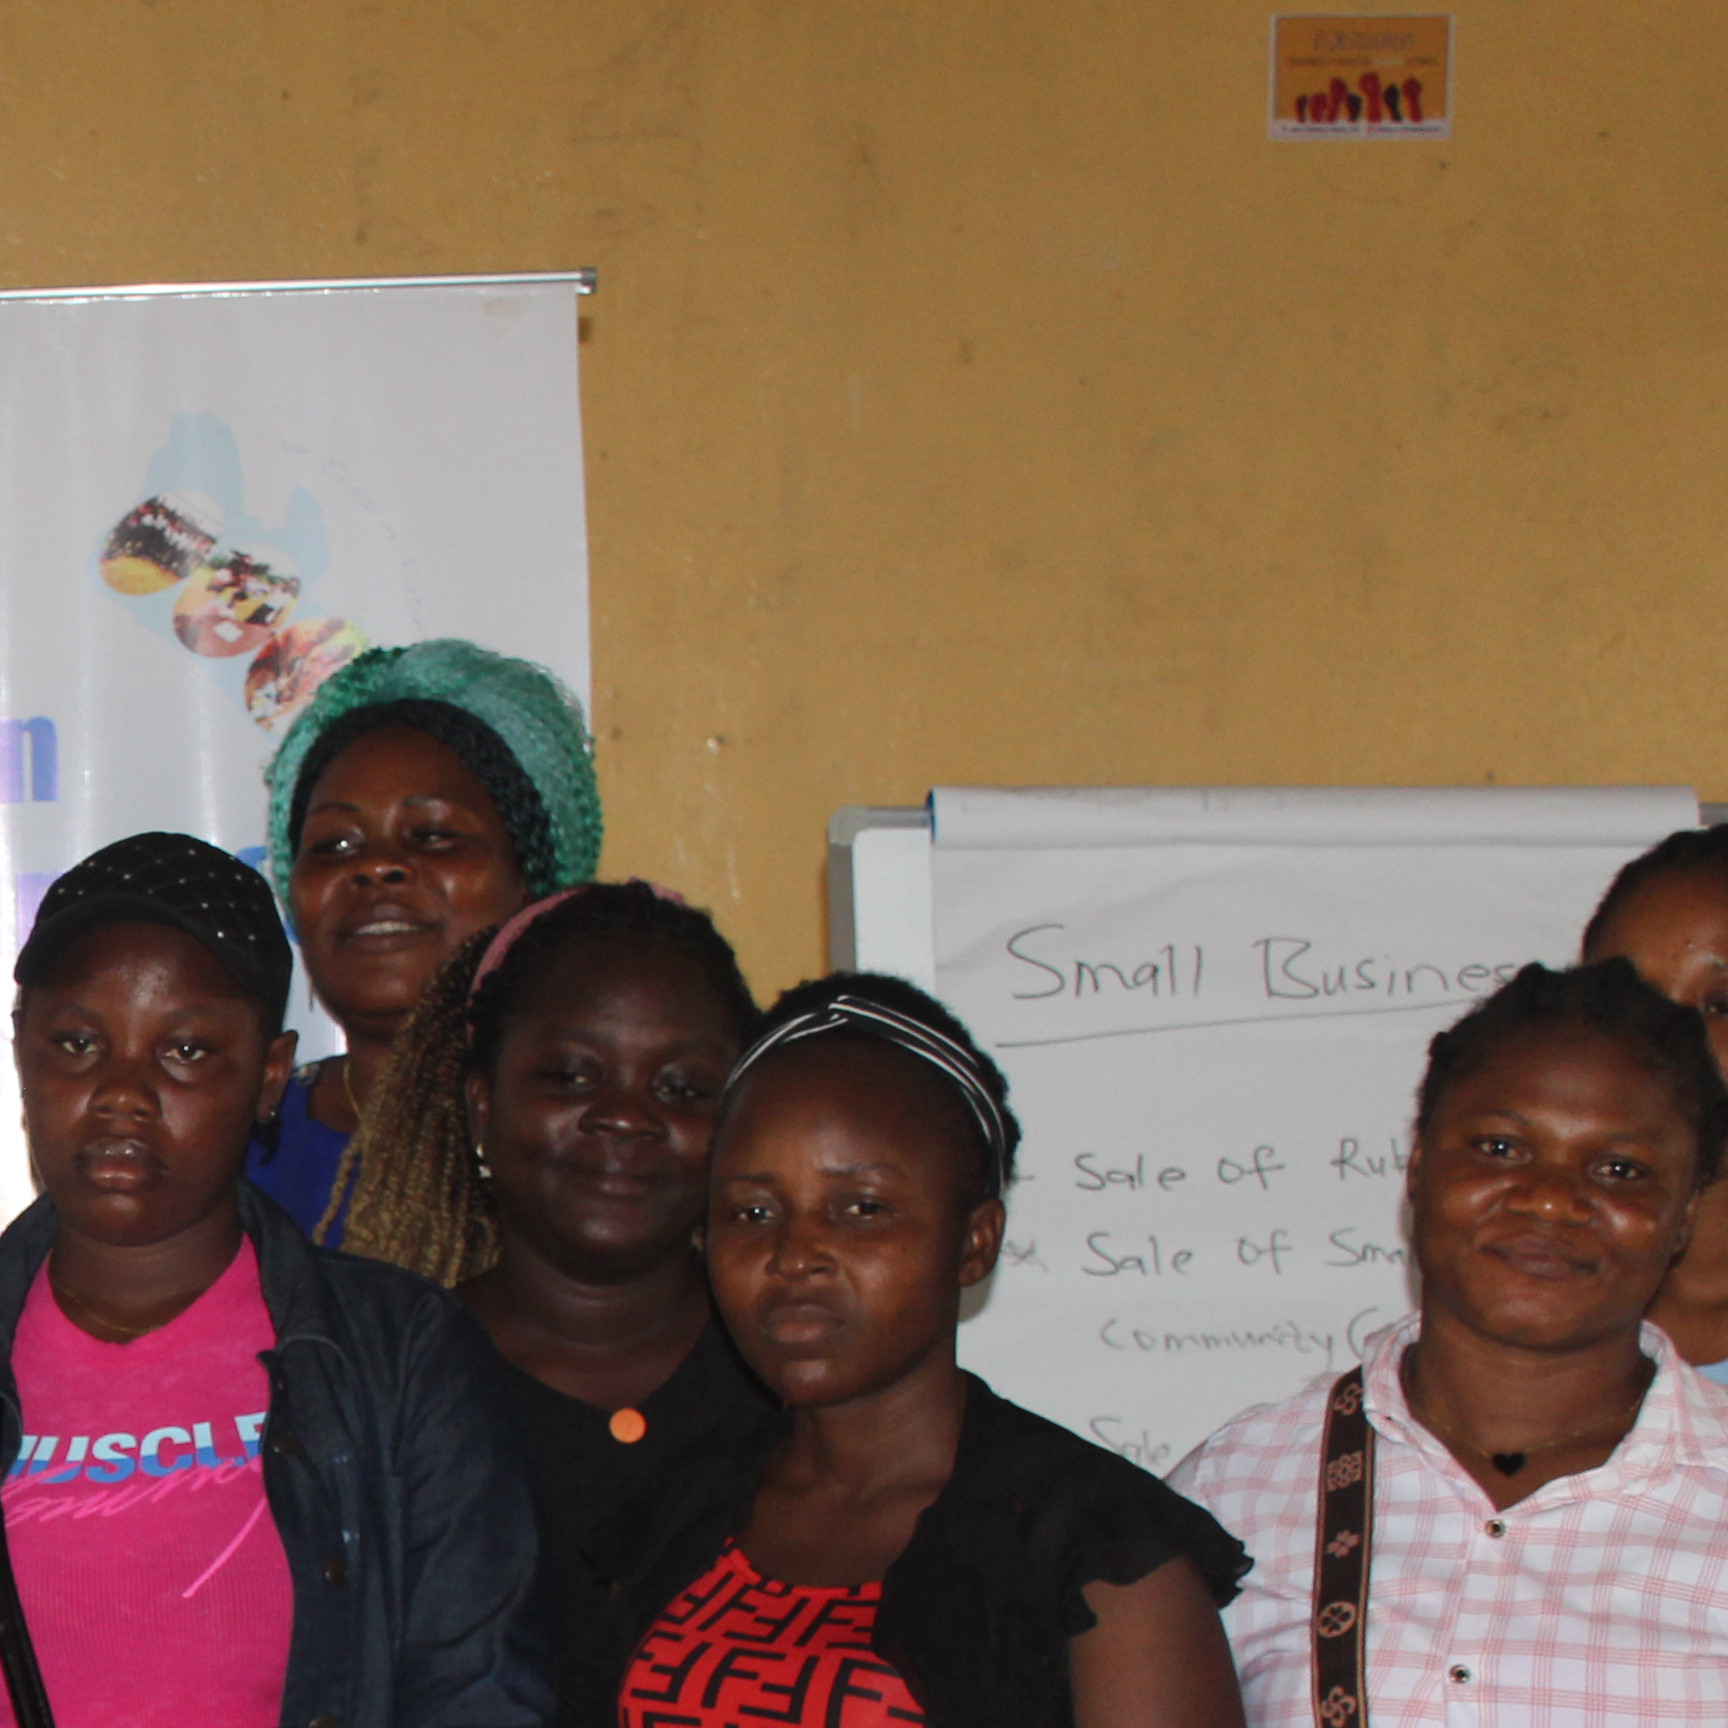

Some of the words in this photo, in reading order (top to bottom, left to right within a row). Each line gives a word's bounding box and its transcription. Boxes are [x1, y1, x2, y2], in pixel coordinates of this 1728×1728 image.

[1007, 924, 1202, 1000] Small
[1074, 1153, 1186, 1191] Sale
[1081, 1231, 1193, 1277] Sale
